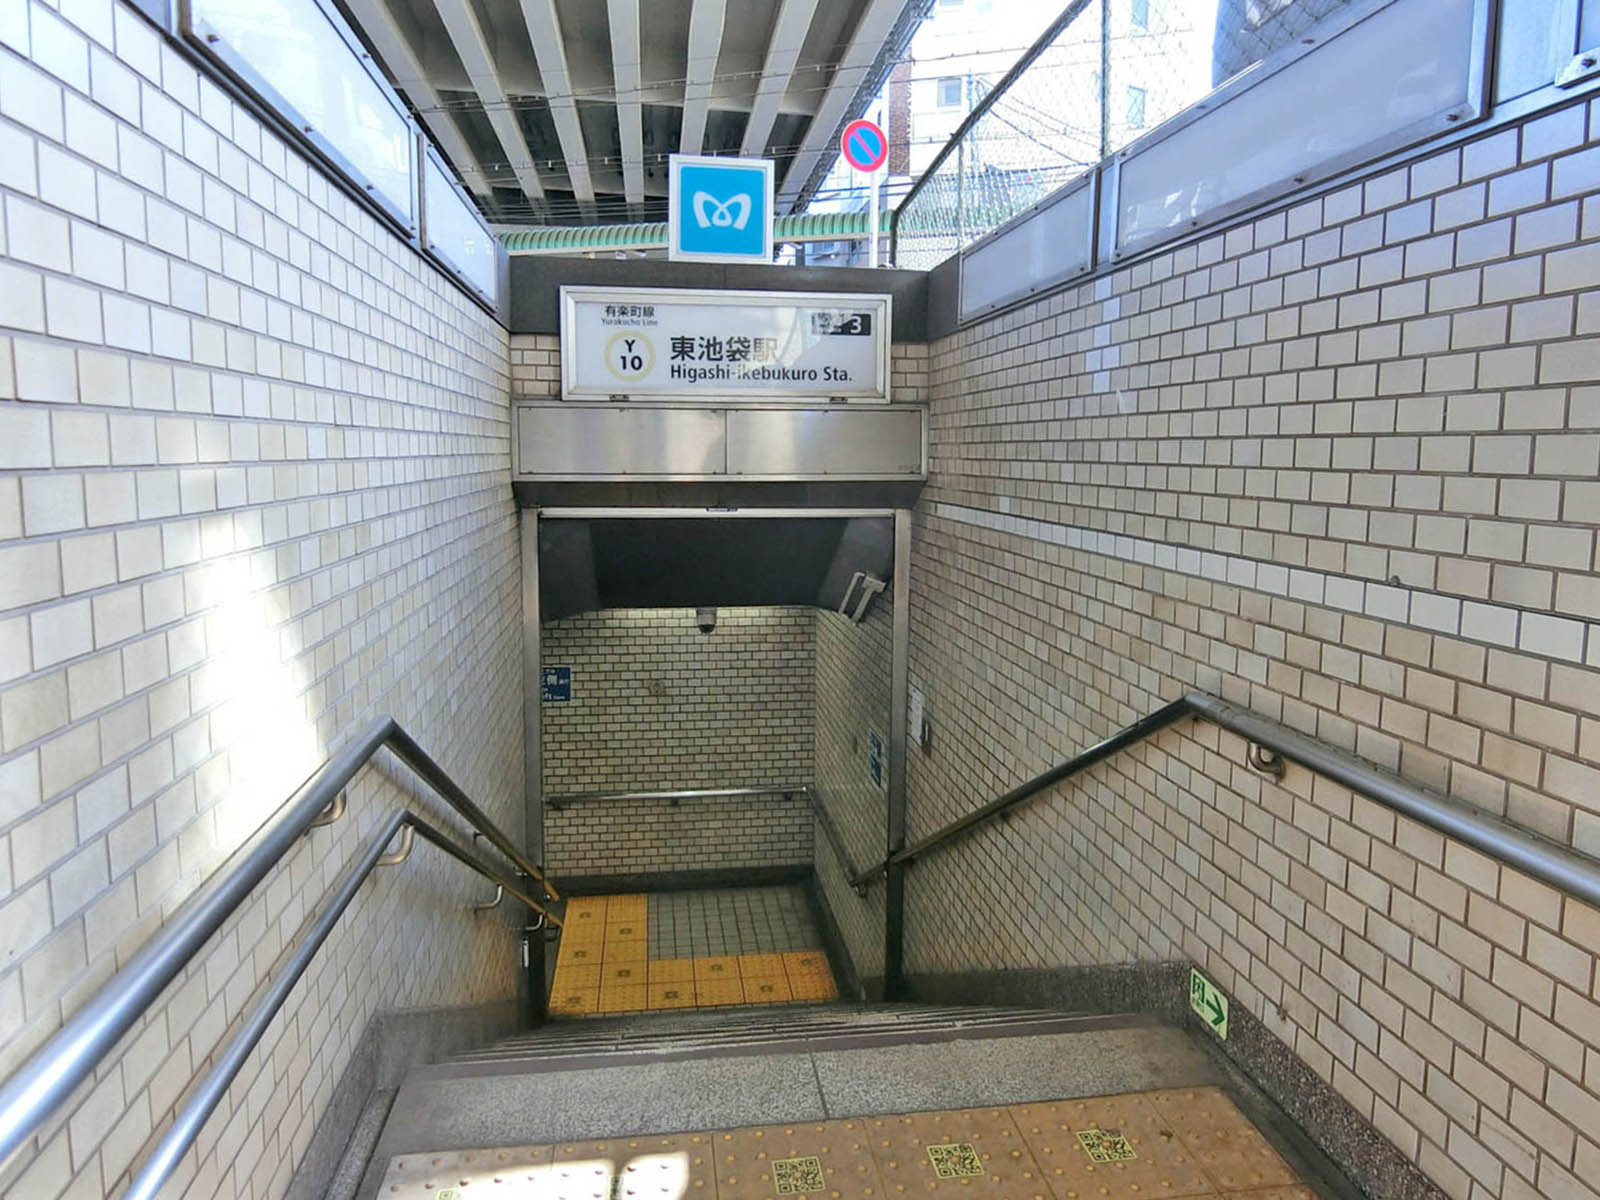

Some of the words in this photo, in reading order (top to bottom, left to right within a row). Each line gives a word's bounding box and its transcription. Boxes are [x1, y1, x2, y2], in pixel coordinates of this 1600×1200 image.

[604, 304, 655, 318] 有楽町線
[850, 315, 862, 334] 3
[624, 339, 636, 353] Y
[670, 335, 778, 362] 東池袋駅
[620, 355, 643, 371] 10
[670, 364, 818, 383] Higashi-ikebukuro
[823, 366, 853, 382] Sta.
